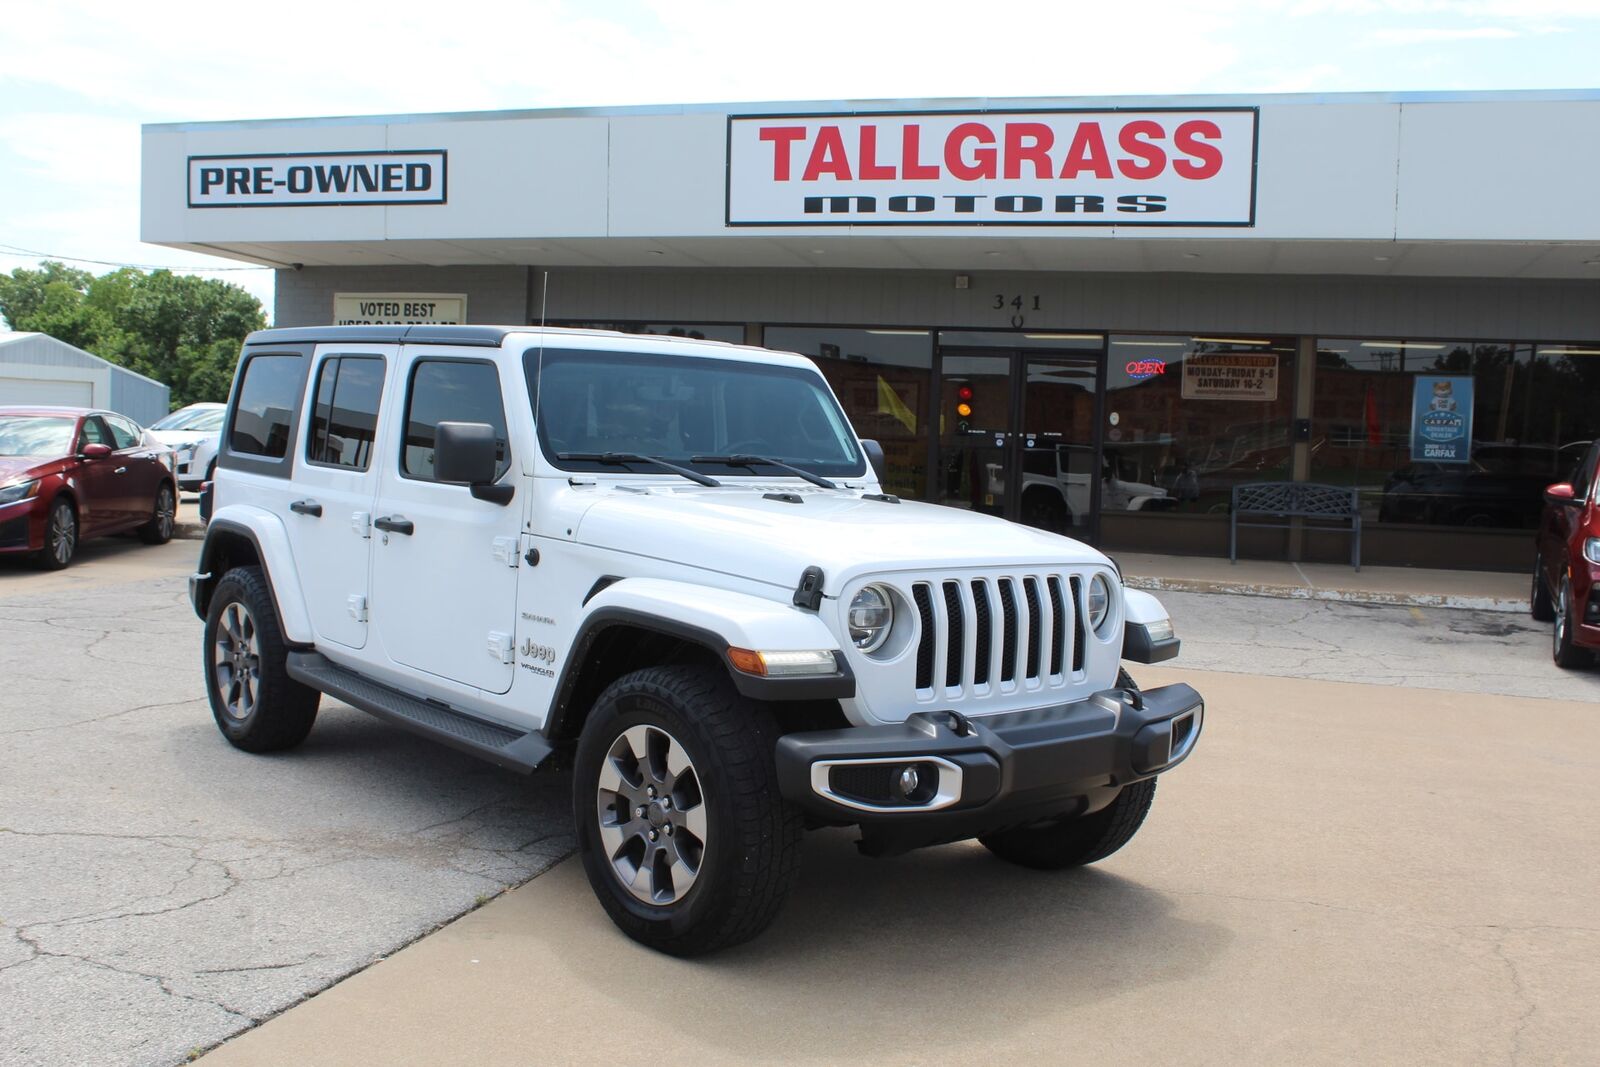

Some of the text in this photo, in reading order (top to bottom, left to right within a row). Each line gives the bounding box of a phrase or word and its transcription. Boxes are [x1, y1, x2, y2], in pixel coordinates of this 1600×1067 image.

[759, 120, 1223, 181] TALLGRASS
[200, 163, 432, 195] PRE-OWNED
[803, 195, 1168, 213] MOTORS
[360, 302, 436, 317] VOTED BEST
[1125, 362, 1167, 374] OPEN
[1187, 367, 1257, 378] MONDAY-FRIDAY
[1197, 378, 1240, 388] SATURDAY
[1424, 449, 1456, 457] CARFAX
[520, 637, 556, 666] Jeep
[520, 662, 555, 676] WRANGLER
